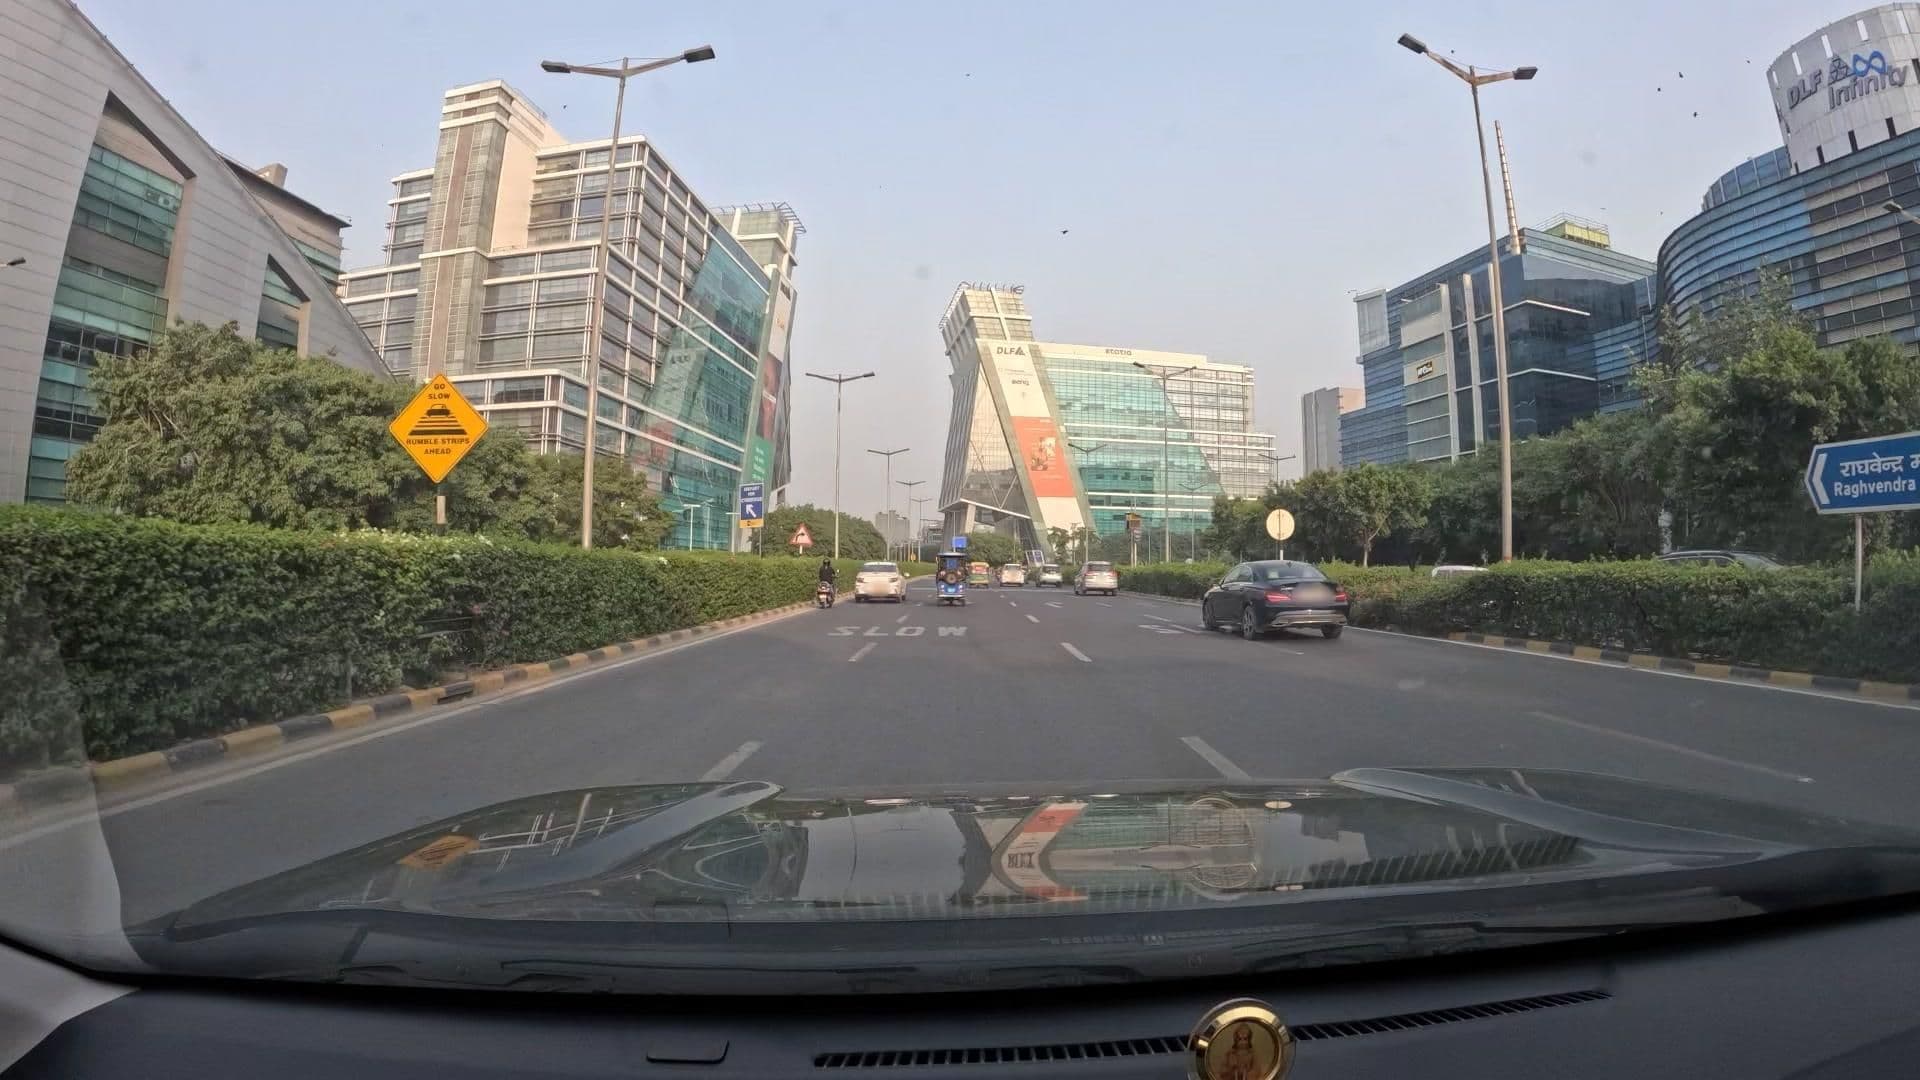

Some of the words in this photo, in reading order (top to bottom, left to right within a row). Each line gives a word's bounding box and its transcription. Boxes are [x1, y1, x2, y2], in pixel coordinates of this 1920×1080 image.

[1787, 69, 1822, 110] DLF
[1828, 64, 1908, 110] Infinity
[996, 346, 1016, 355] DLF
[406, 438, 439, 446] RUMBLE
[441, 437, 470, 445] STRIPS
[424, 447, 451, 455] AHEAD
[1839, 451, 1905, 477] राघवेन्द्र
[1833, 476, 1917, 498] Raghvendra
[826, 625, 969, 637] SLOW
